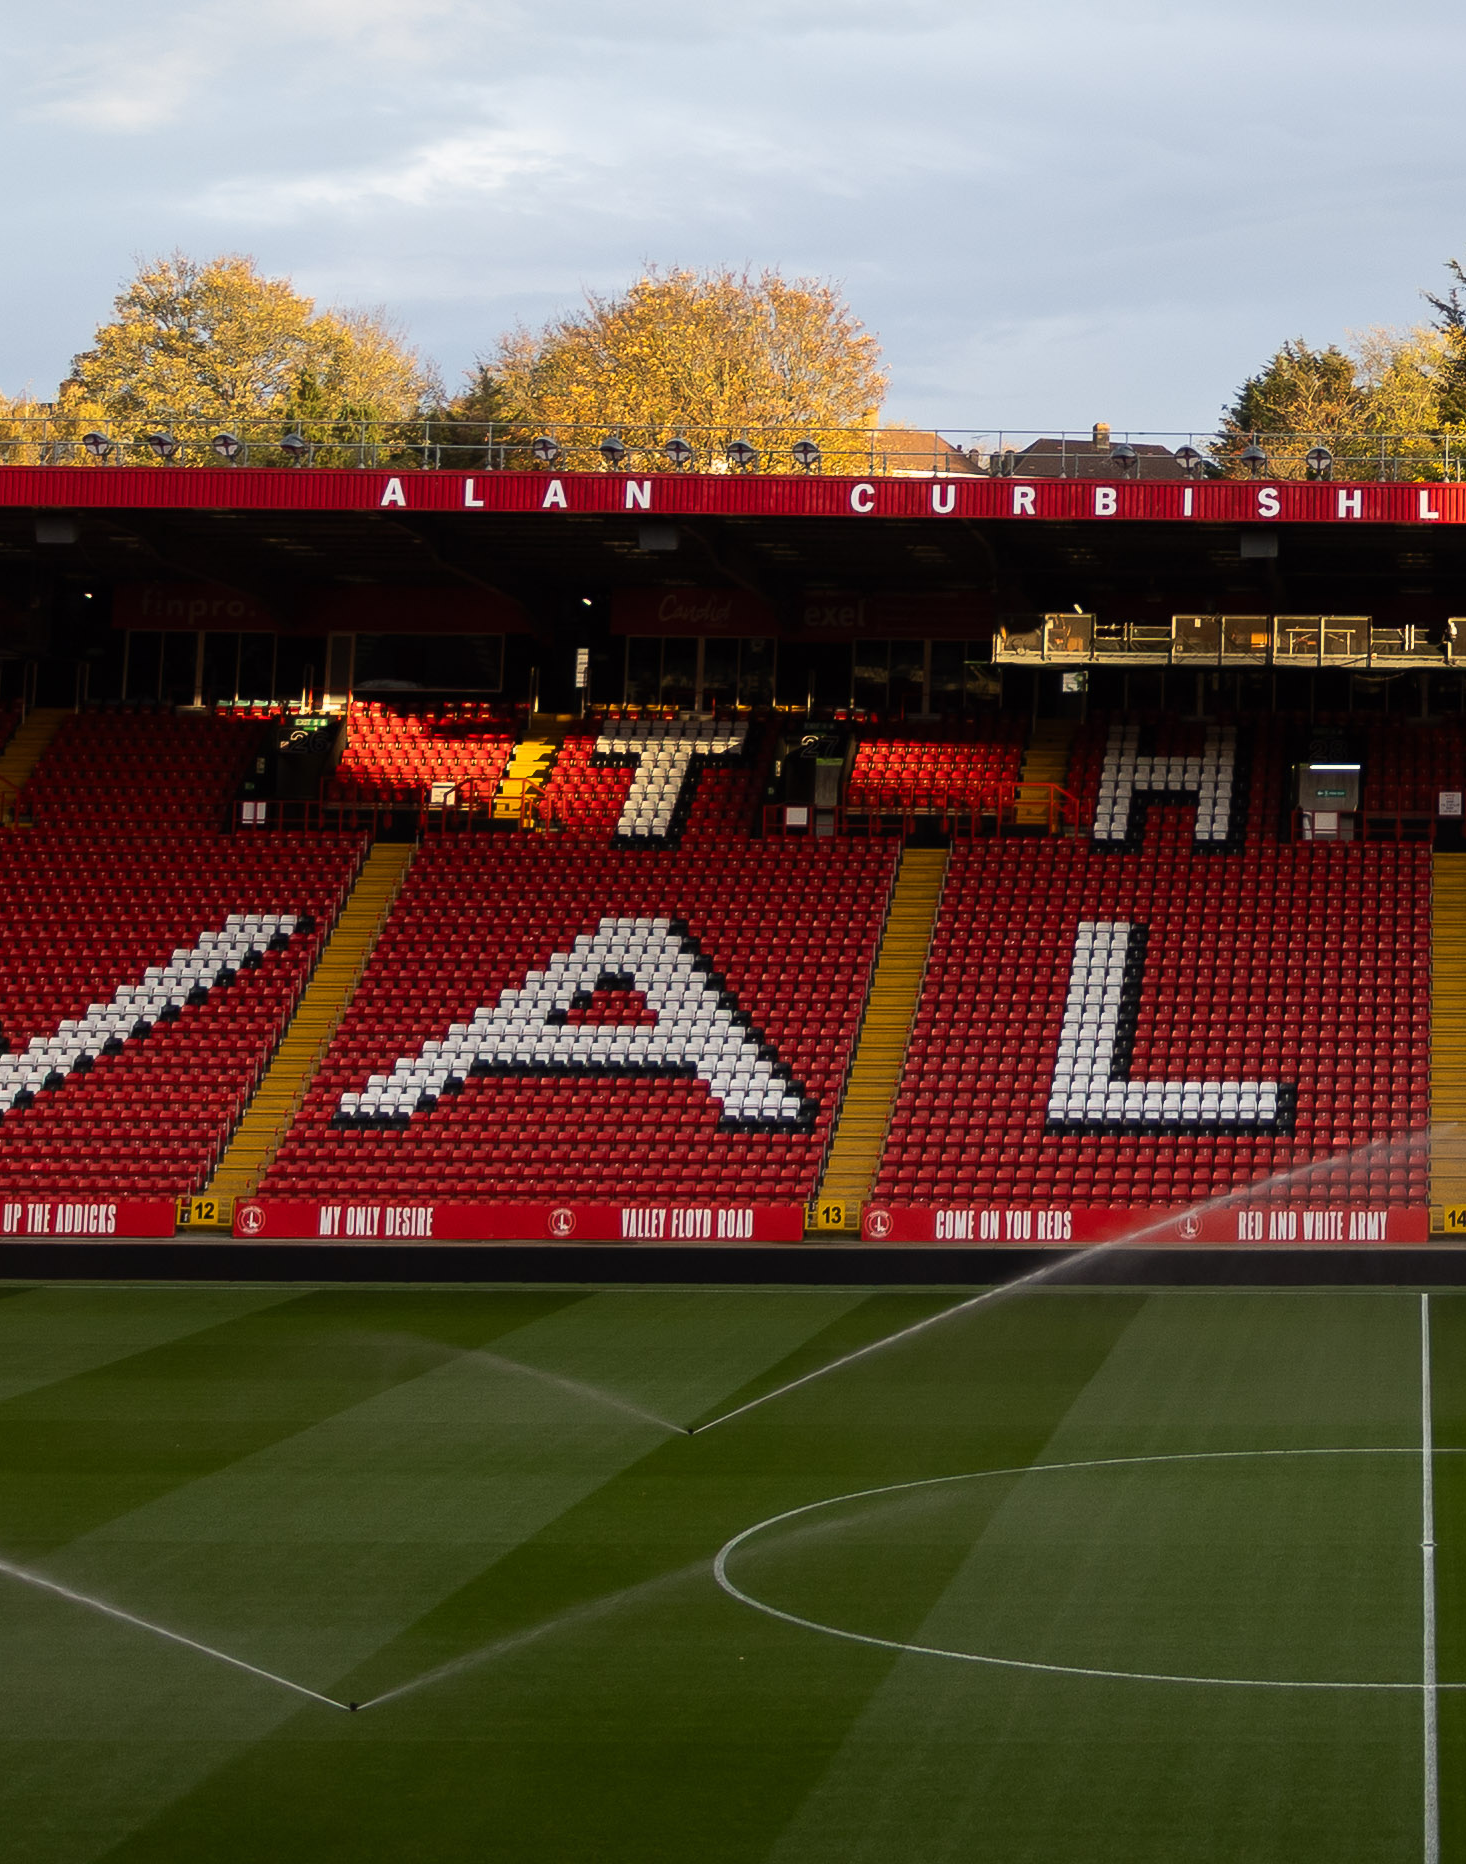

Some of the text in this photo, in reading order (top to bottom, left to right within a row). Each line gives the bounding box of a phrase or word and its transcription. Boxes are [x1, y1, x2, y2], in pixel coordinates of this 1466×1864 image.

[380, 478, 653, 510] ALAN
[289, 730, 330, 753] 26
[800, 735, 838, 758] 27
[1310, 740, 1350, 761] 28
[4, 1204, 116, 1233] UP THE ADDICKS
[195, 1202, 214, 1219] 12
[320, 1207, 433, 1236] MY ONLY DESIRE
[623, 1209, 753, 1238] VALLEY FLOYD ROAD
[822, 1206, 841, 1224] 13
[936, 1210, 1071, 1239] COME ON YOU REDS
[1239, 1212, 1387, 1240] RED AND WHITE ARMY
